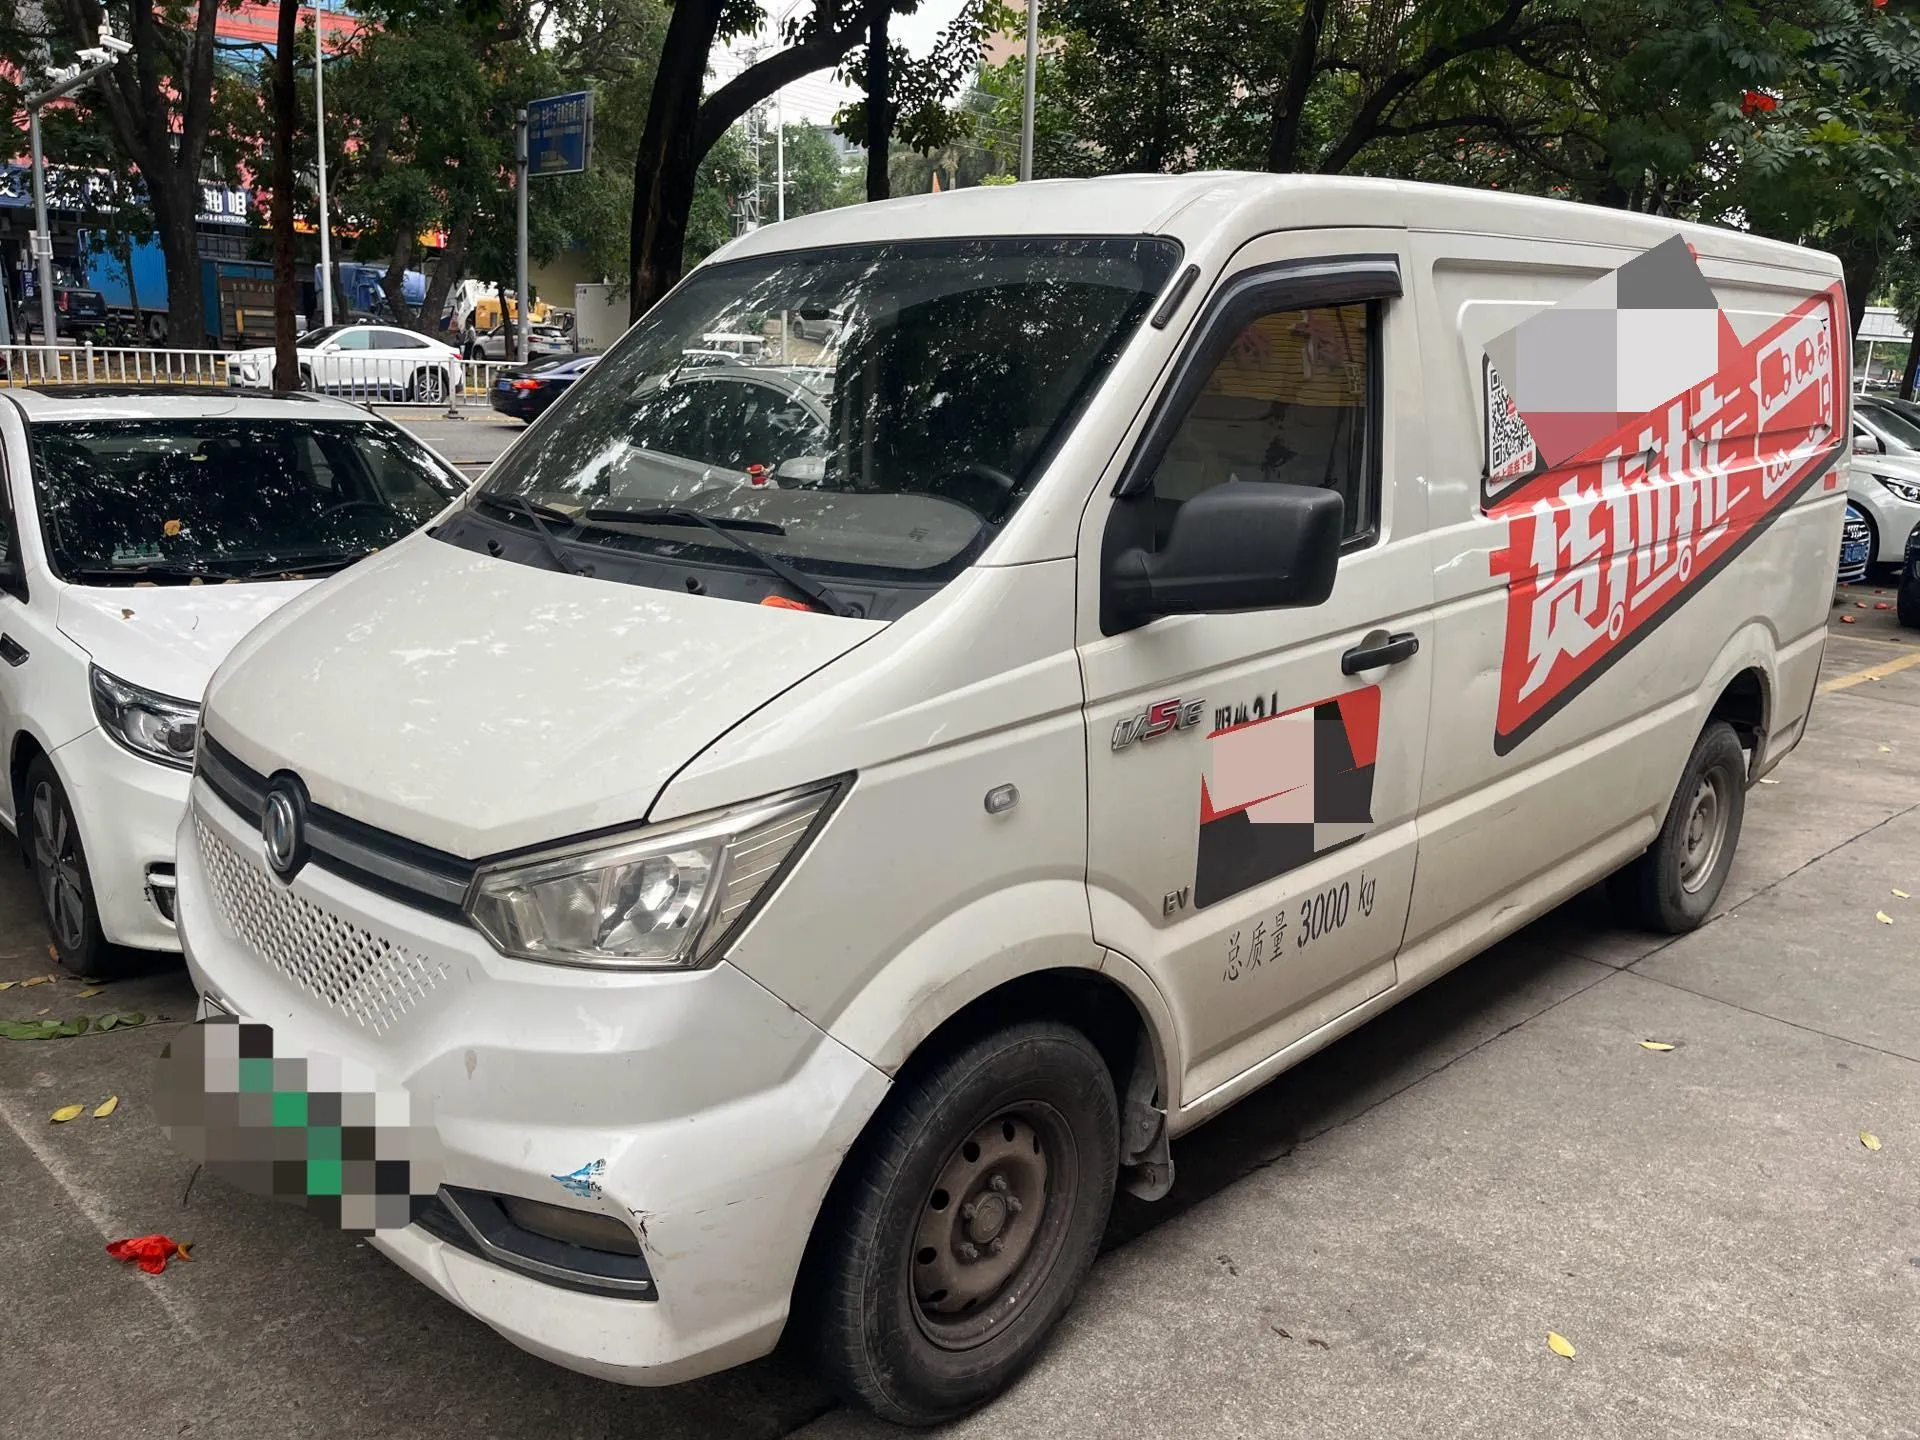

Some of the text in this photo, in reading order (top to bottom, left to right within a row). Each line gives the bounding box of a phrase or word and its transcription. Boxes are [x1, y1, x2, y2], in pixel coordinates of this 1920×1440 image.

[1518, 382, 1730, 703] 货拉拉
[1163, 885, 1190, 917] EV
[1223, 871, 1377, 981] 总质量 3000 kg
